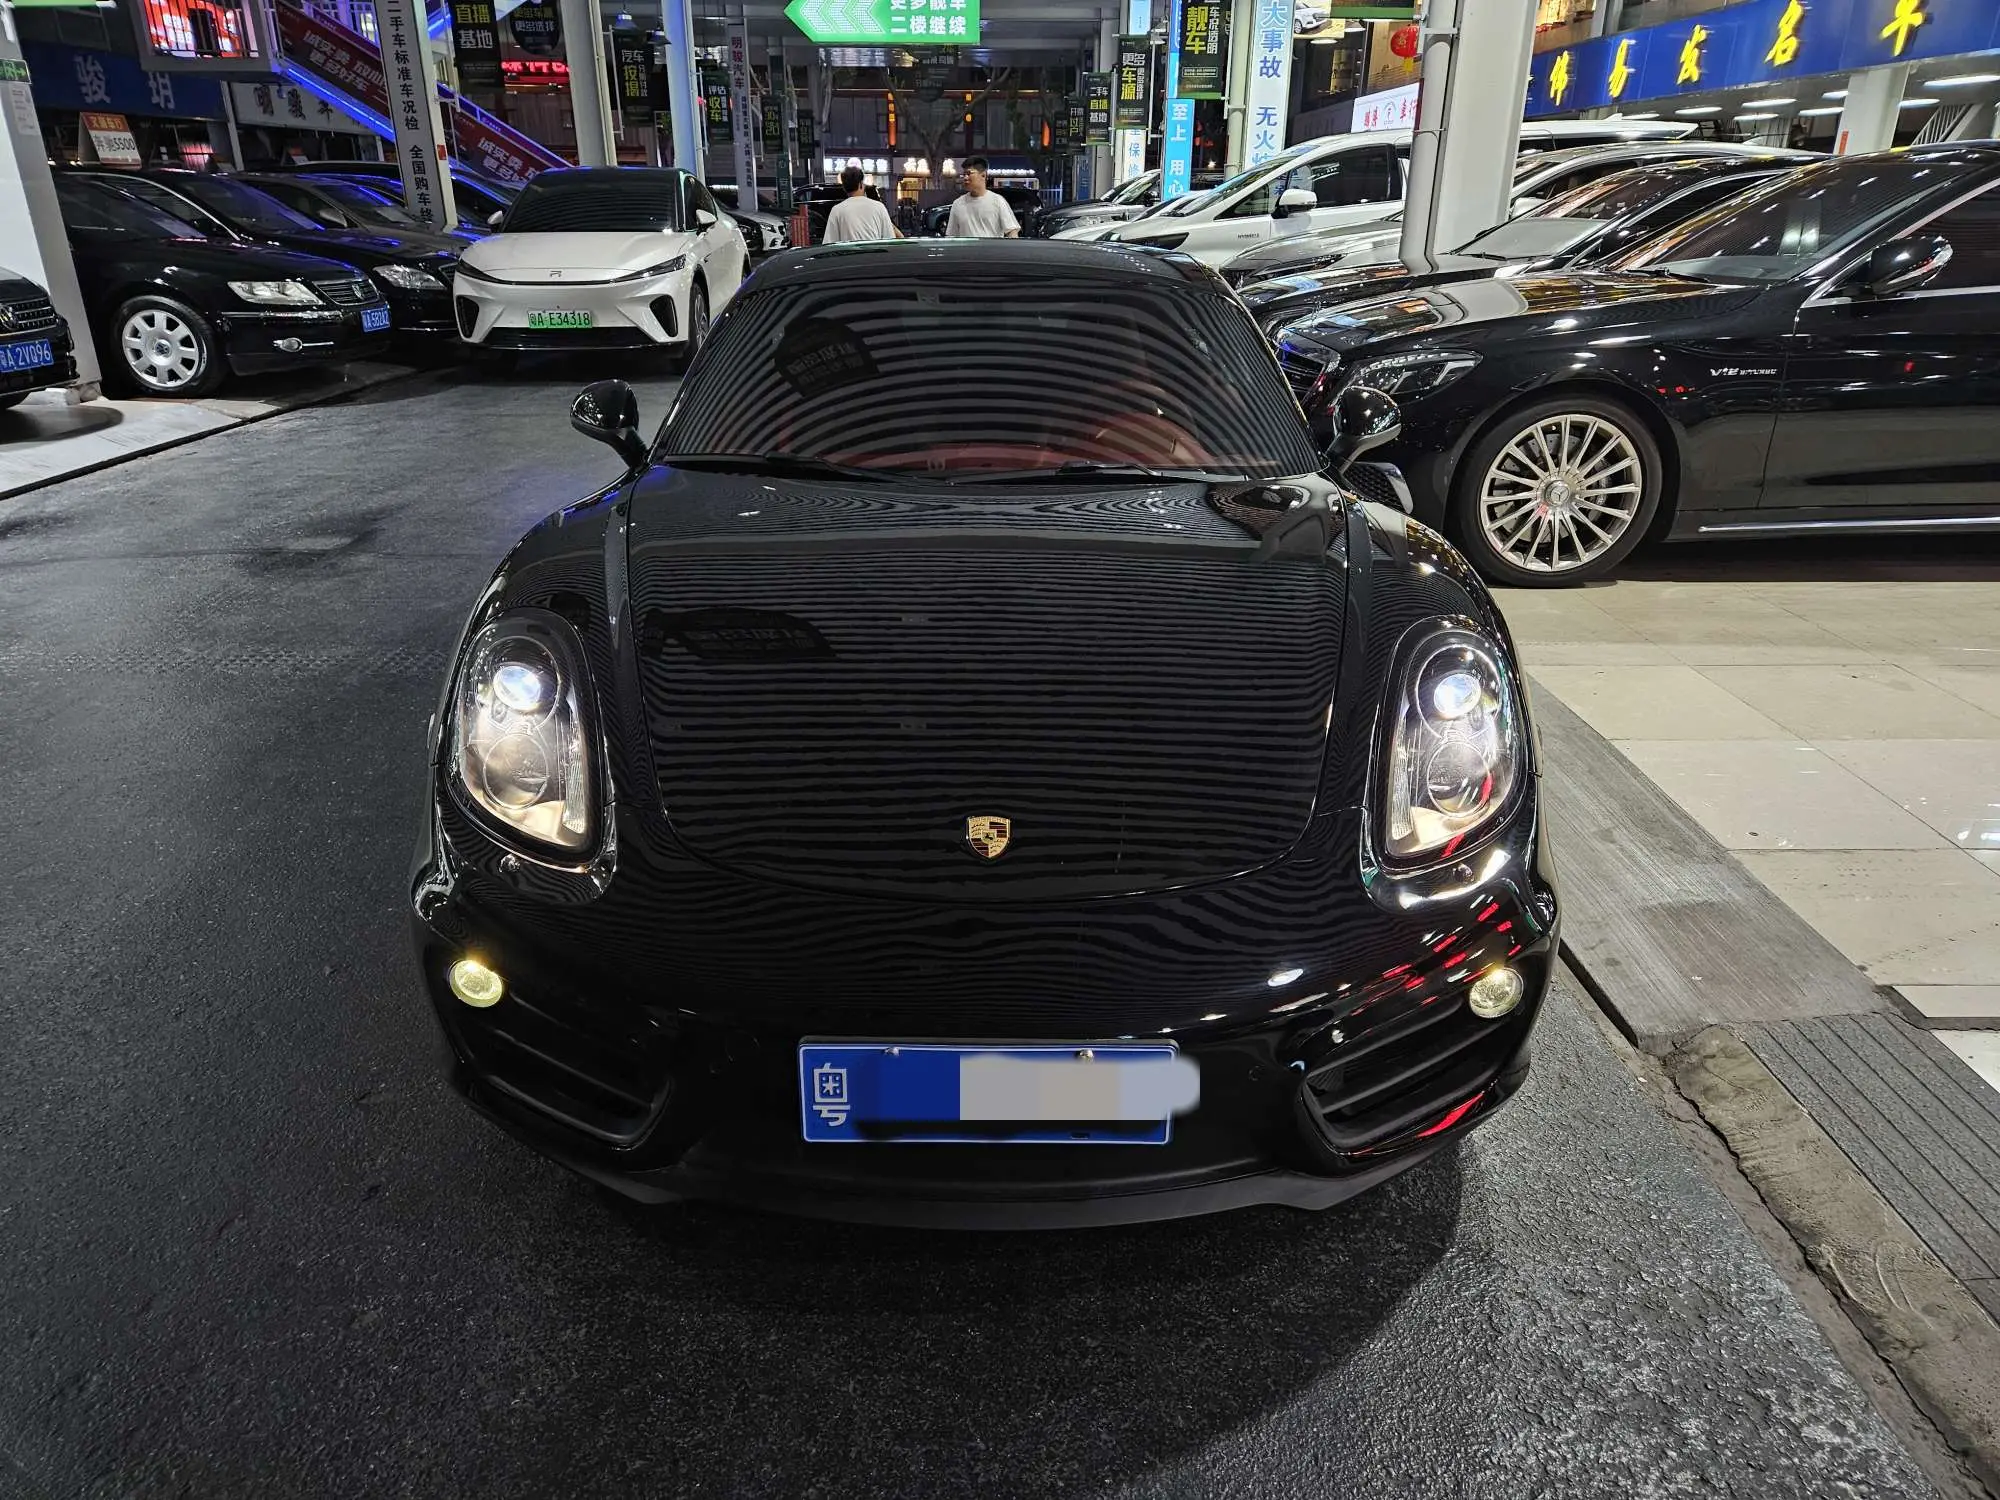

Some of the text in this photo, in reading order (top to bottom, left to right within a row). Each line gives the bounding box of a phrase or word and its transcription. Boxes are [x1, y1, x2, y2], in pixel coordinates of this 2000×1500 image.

[456, 4, 490, 24] 直播
[890, 15, 966, 35] 二楼继续
[1185, 6, 1208, 55] 靓车
[458, 29, 493, 49] 基地
[1122, 52, 1145, 66] 更多
[1089, 86, 1109, 97] 二手车
[1121, 67, 1137, 100] 车源
[708, 96, 721, 122] 收车
[1089, 112, 1108, 123] 基地
[1170, 103, 1189, 142] 至上
[813, 1062, 851, 1127] 粤
